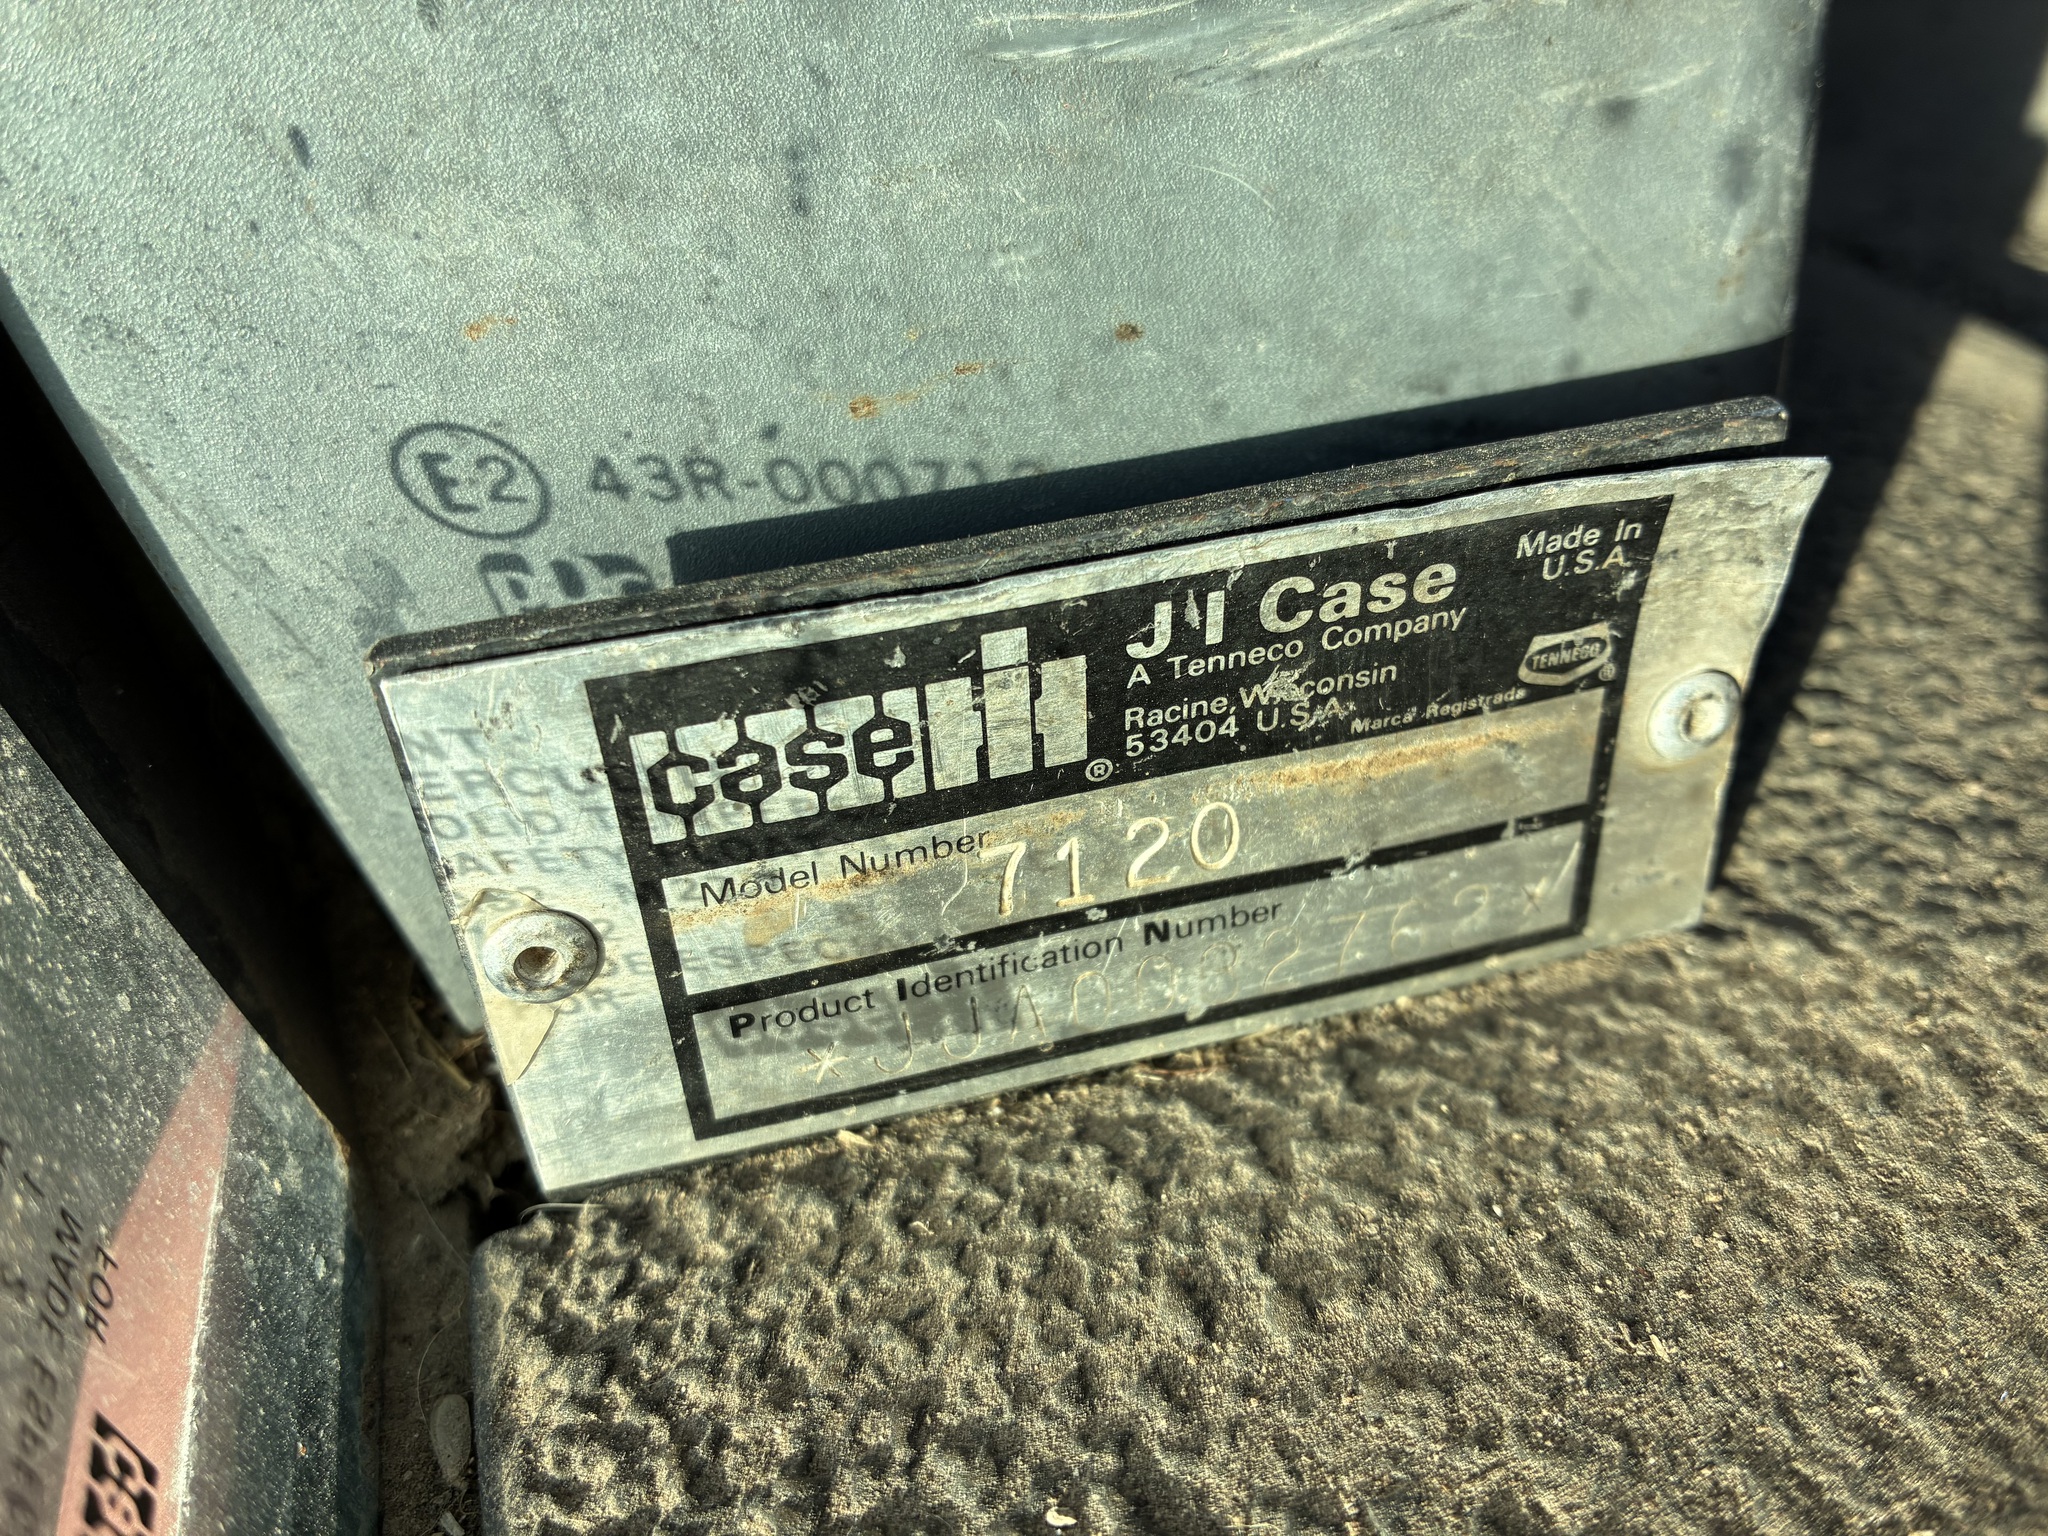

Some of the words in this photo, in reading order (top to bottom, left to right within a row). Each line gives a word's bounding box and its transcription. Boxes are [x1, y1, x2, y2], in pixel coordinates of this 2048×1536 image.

[1516, 524, 1601, 559] Made
[1613, 518, 1643, 542] In
[1125, 602, 1172, 660] J
[1258, 562, 1457, 634] Case
[1126, 663, 1152, 689] A
[1166, 640, 1304, 680] Tenneco
[1320, 605, 1467, 652] Company
[1124, 697, 1238, 732] Racine,
[1126, 715, 1240, 757] 53404
[1350, 712, 1414, 735] Marca
[701, 859, 819, 907] Model
[840, 829, 990, 880] Number
[977, 821, 1242, 917] 7120
[729, 989, 874, 1039] Product
[896, 934, 1124, 1002] Identification
[1143, 902, 1283, 947] Number
